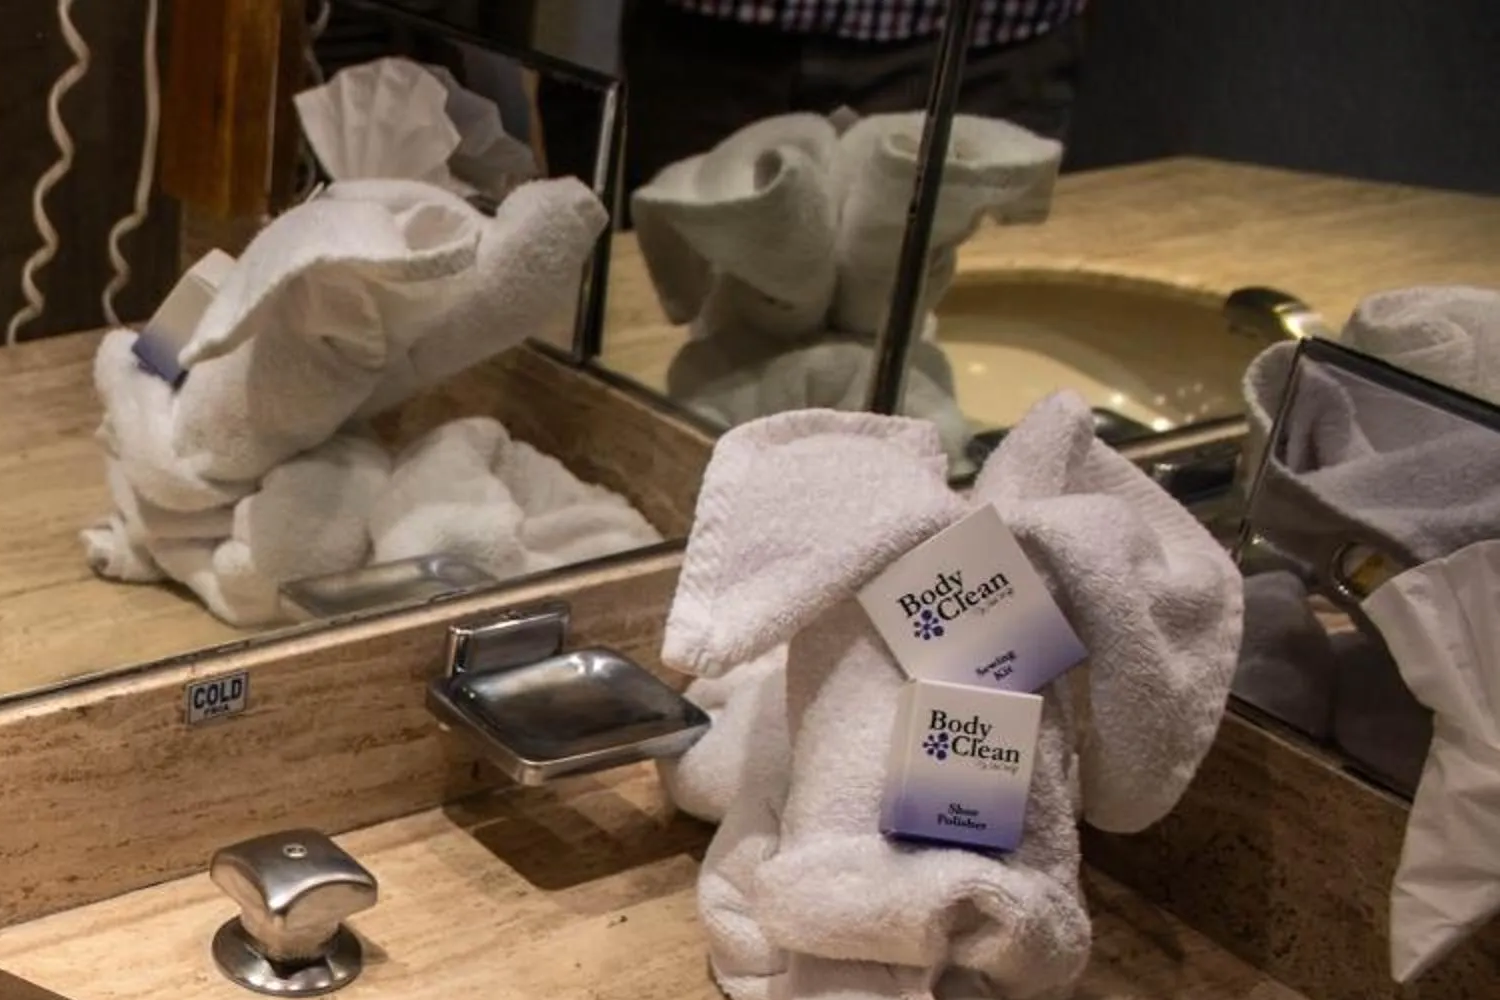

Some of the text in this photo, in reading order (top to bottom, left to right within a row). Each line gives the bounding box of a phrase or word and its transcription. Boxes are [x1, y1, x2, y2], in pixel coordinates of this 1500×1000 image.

[896, 570, 963, 618] Body
[937, 573, 1010, 621] Clean
[194, 680, 242, 709] COLD
[929, 709, 993, 742] Body
[951, 735, 1020, 763] Clean
